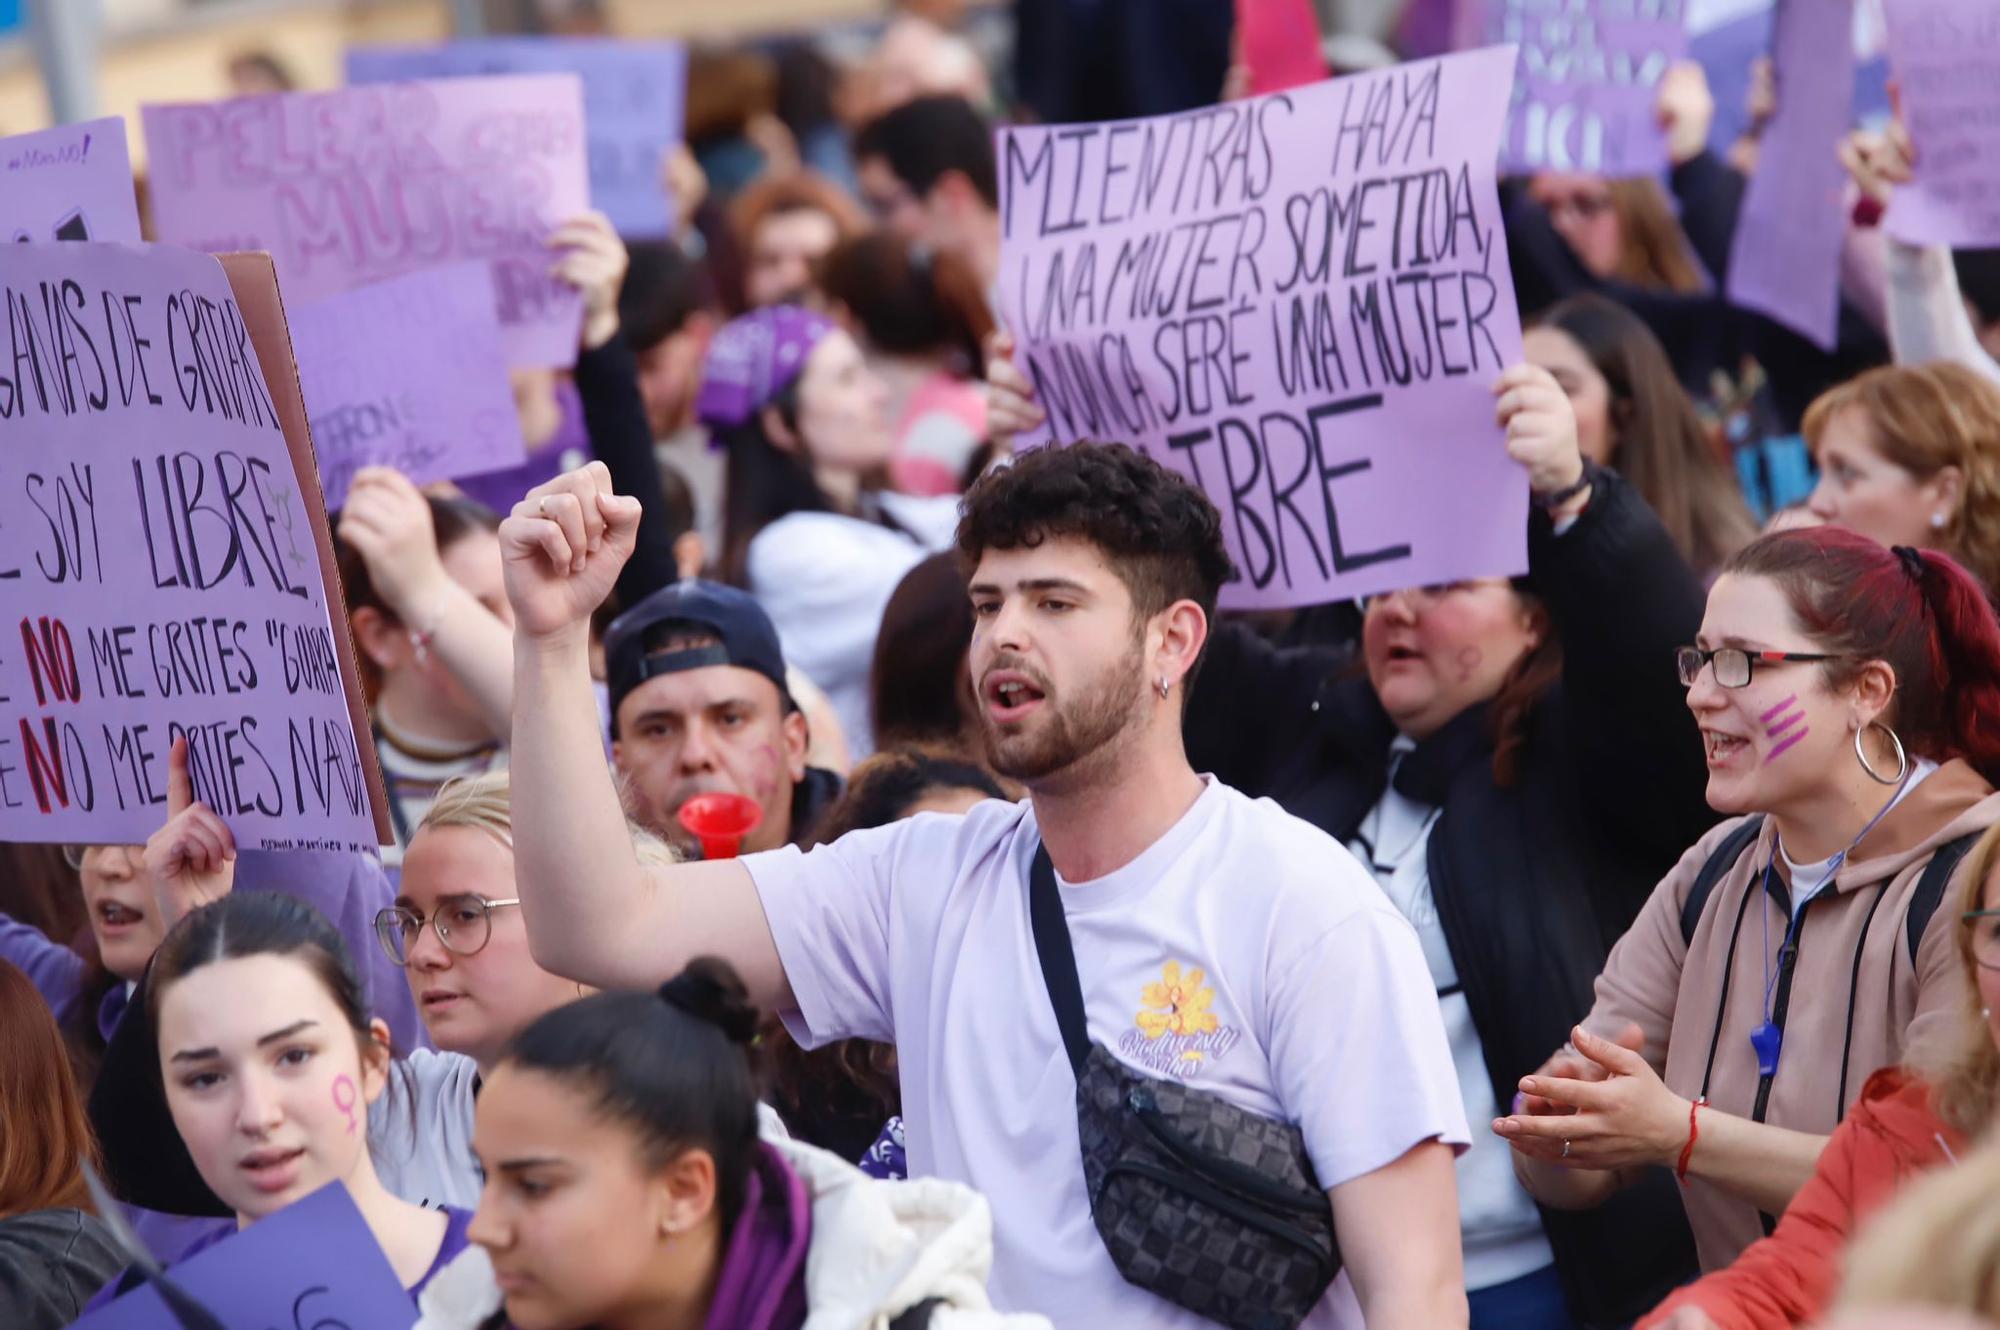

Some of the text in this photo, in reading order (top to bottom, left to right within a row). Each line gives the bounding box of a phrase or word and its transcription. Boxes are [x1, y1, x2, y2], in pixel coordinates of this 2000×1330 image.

[1003, 95, 1294, 238] MIENTRAS
[1332, 62, 1442, 176] HAYA
[273, 157, 553, 278] MUJER
[1020, 162, 1494, 346] UNA MUJER SOMETIDA,
[102, 290, 163, 407] DE
[167, 289, 281, 431] GRITAR
[1026, 271, 1504, 440] NUNCA SERÉ UNA MUJER
[26, 461, 102, 584] SOY
[20, 616, 81, 707] NO
[87, 625, 146, 698] ME
[148, 617, 258, 697] GRITES
[18, 716, 95, 814] NO
[103, 722, 168, 812] ME
